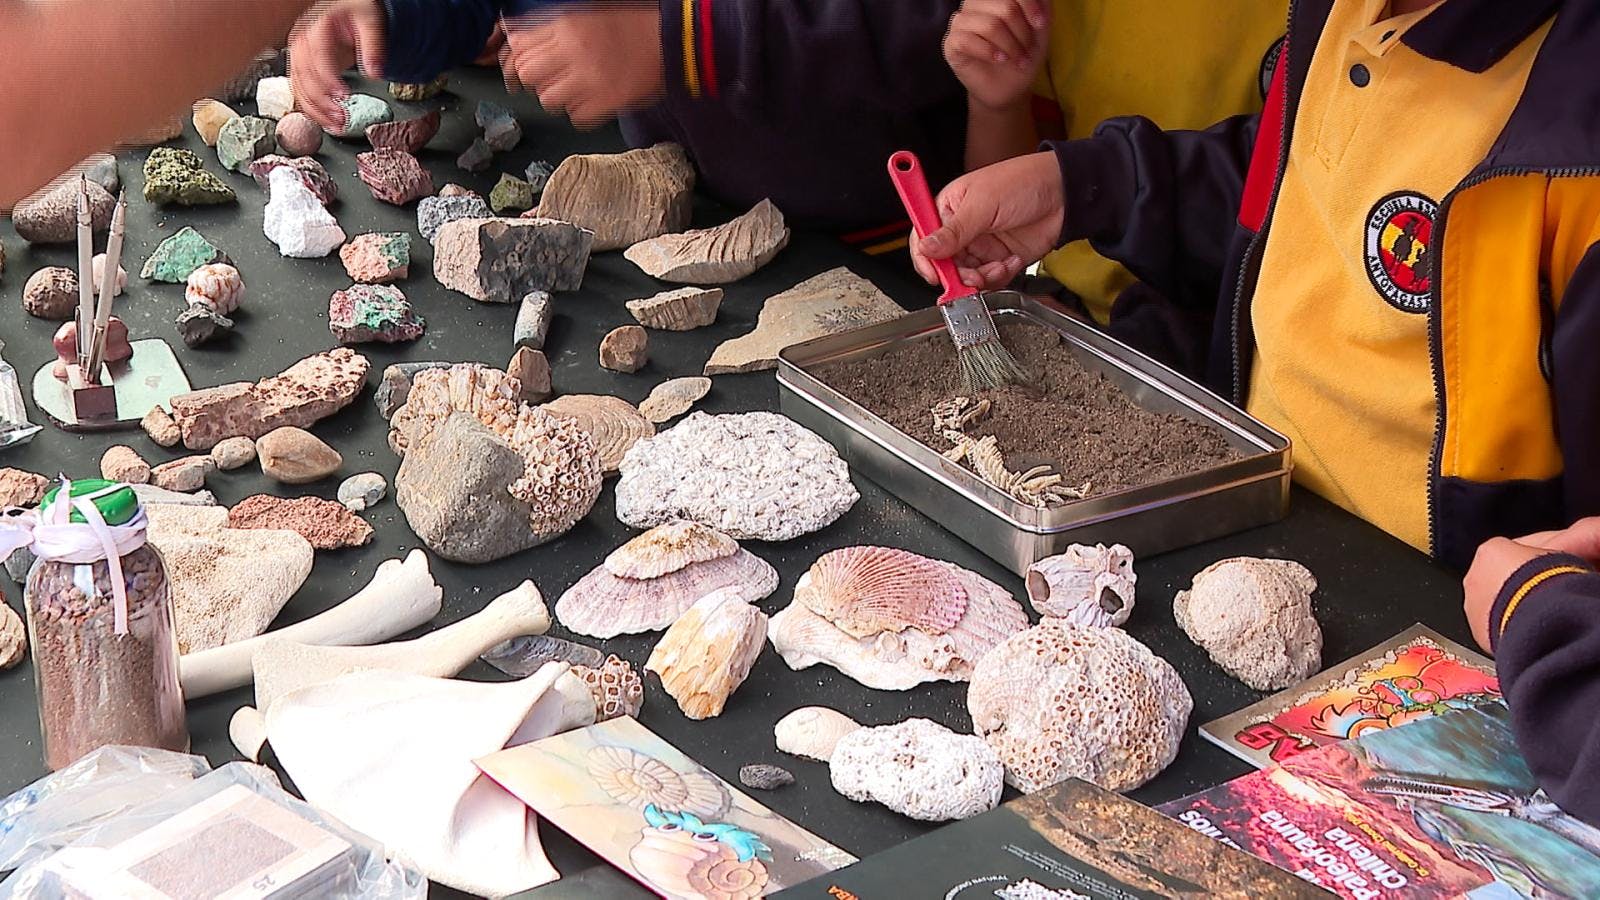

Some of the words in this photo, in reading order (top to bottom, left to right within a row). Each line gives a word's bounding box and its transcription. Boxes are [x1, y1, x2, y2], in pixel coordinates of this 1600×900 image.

[1371, 197, 1413, 230] ESCUELA
[1260, 809, 1381, 900] Paleofauna
[1324, 826, 1407, 889] Chilena
